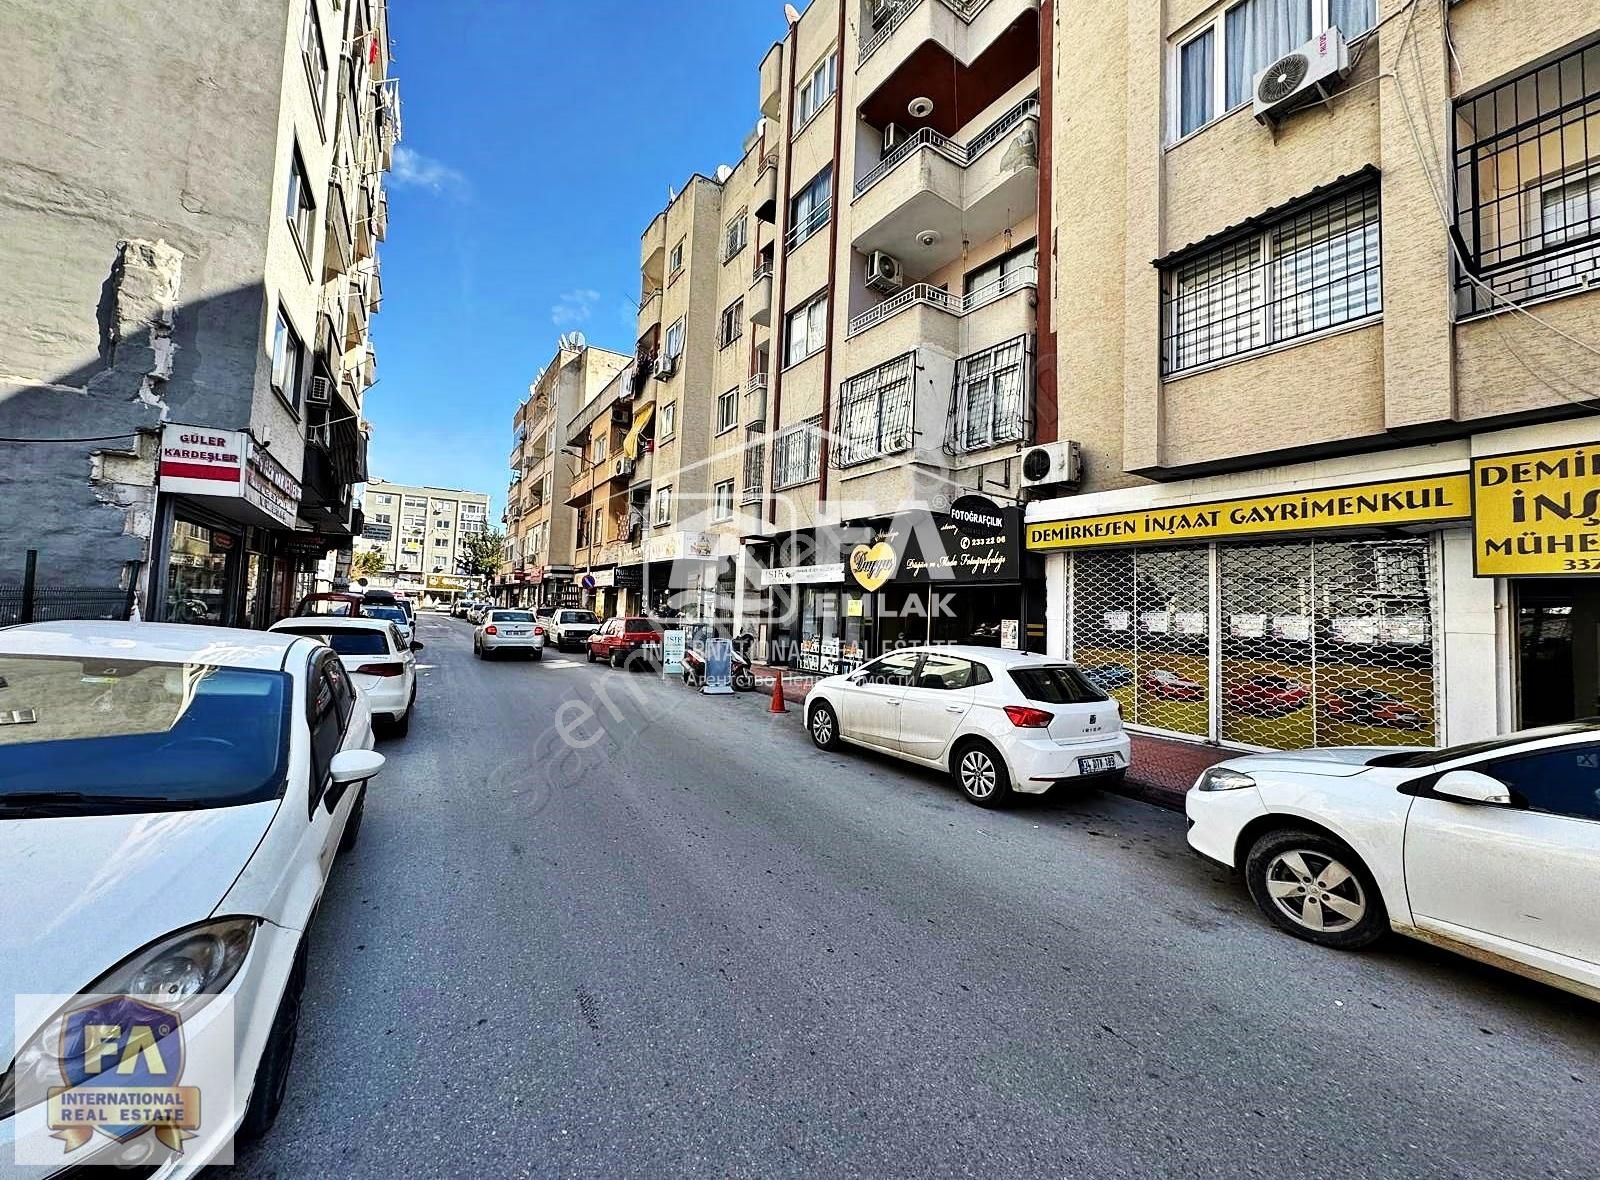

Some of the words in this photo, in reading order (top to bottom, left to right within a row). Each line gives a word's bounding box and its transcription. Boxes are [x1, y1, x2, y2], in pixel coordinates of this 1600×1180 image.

[179, 432, 227, 448] GÜLER
[164, 447, 239, 463] KARDEŞLER
[951, 508, 1003, 529] FOTOĞRAFÇILIK
[1031, 521, 1137, 543] DEMİRKESEN
[1144, 509, 1221, 535] İNŞAAT
[1229, 486, 1454, 525] GAYRİMENKUL
